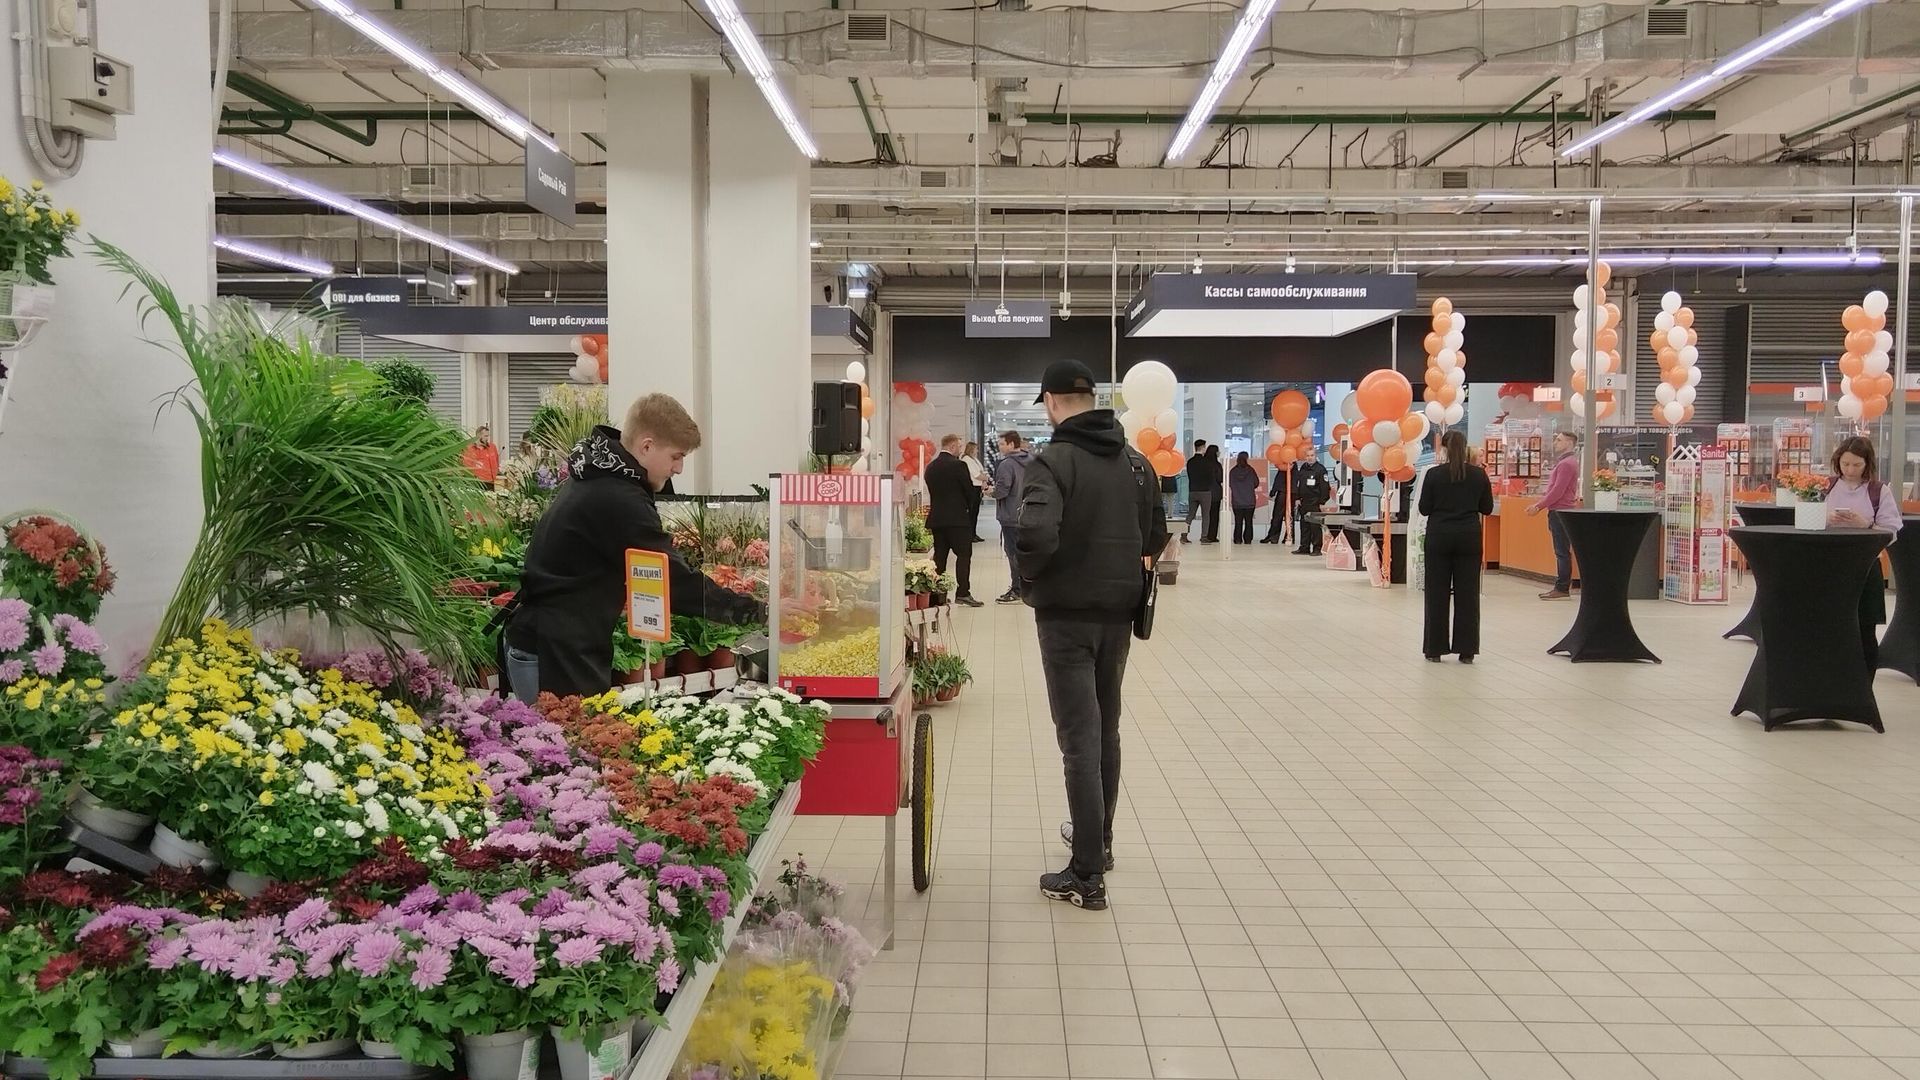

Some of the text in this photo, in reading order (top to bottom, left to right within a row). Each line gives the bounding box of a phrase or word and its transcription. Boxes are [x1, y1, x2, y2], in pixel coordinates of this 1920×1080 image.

[348, 294, 364, 304] для
[365, 292, 400, 303] бизнеса
[1205, 285, 1367, 300] Кассы самообслуживания
[529, 315, 557, 327] Центр
[971, 314, 1044, 324] Выход без покупок
[1606, 378, 1612, 386] 2
[1701, 449, 1725, 458] Sanita
[821, 485, 838, 495] CORN
[632, 567, 662, 579] Акция!
[643, 615, 658, 626] 699
